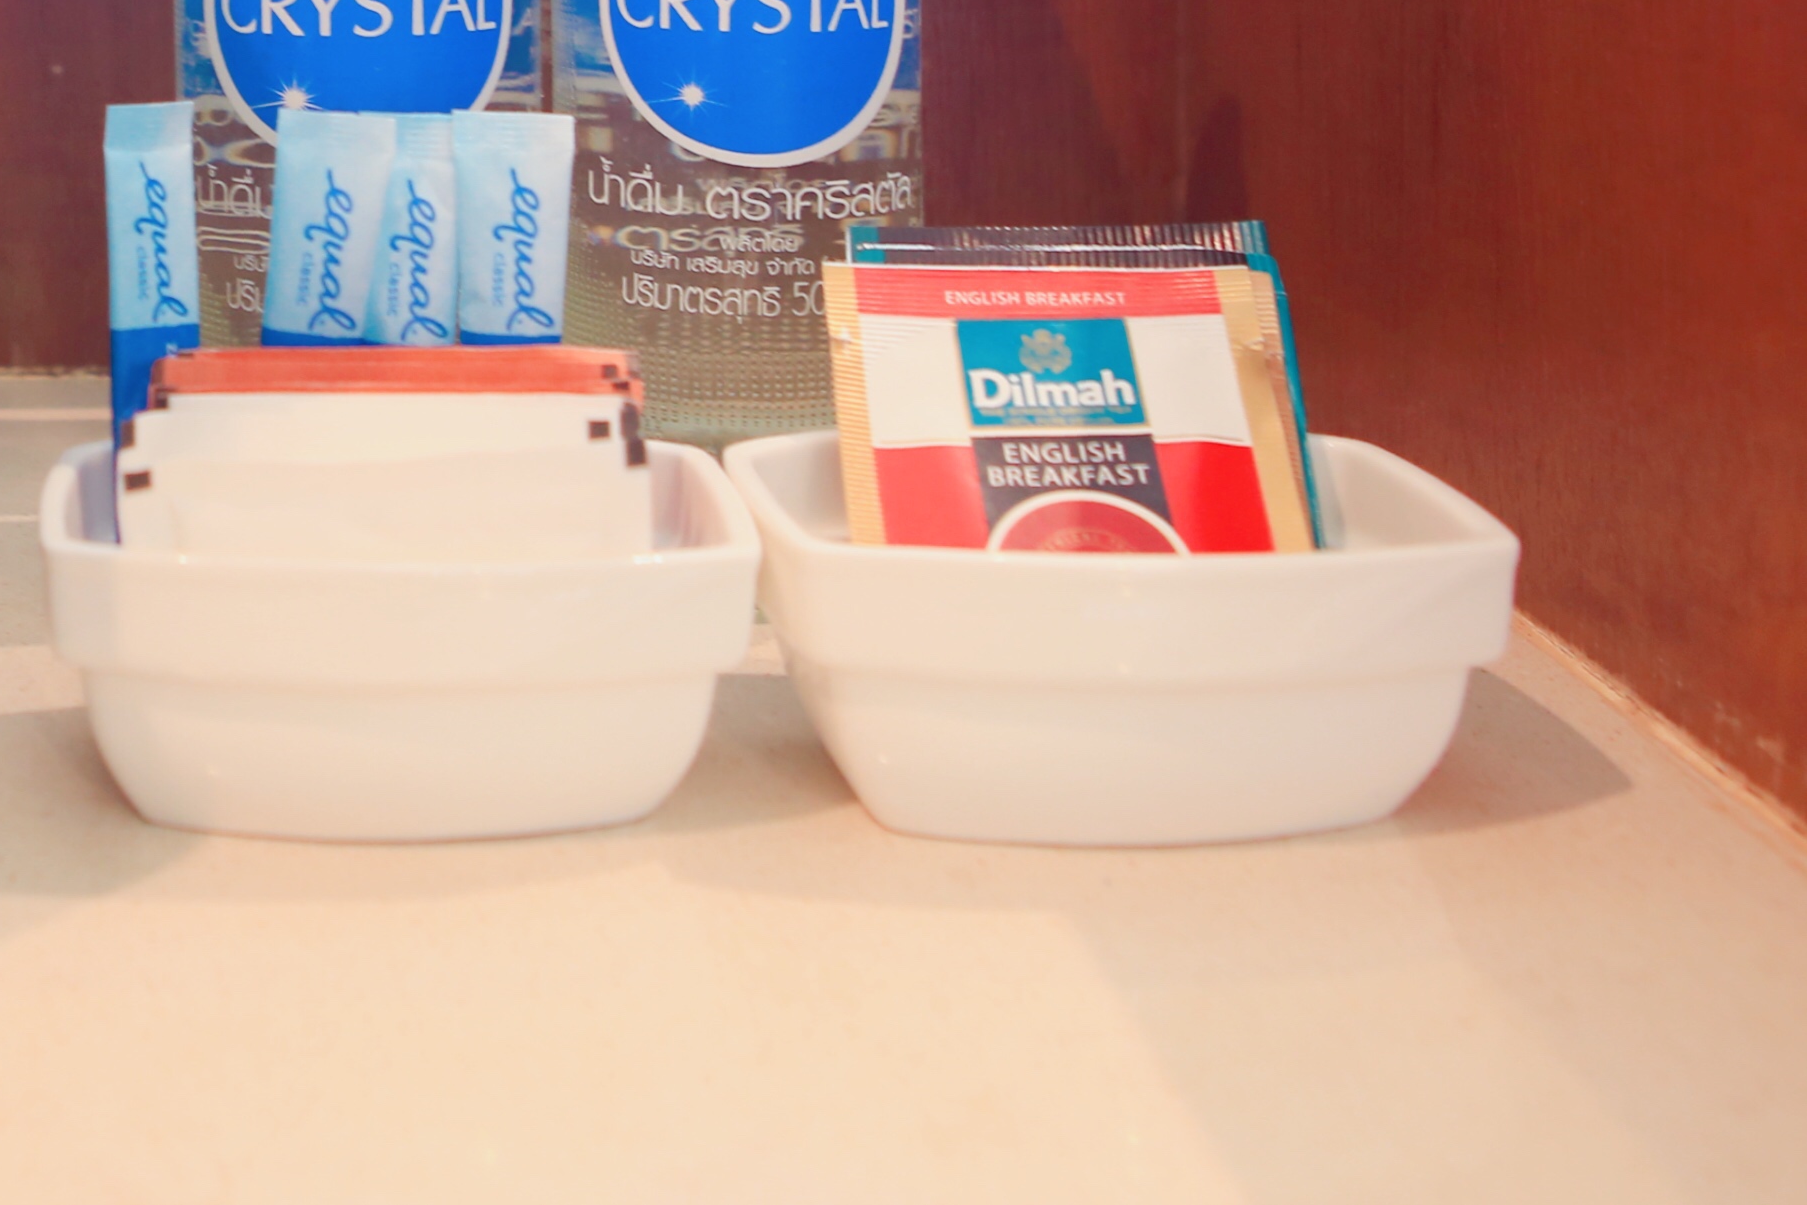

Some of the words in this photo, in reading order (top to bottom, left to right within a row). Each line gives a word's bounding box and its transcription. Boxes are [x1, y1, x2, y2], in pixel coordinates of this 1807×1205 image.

[133, 160, 189, 324] equal
[303, 168, 357, 332] equal
[389, 178, 448, 342] equal
[491, 167, 555, 333] equal
[945, 290, 1021, 307] ENGLISH
[1025, 291, 1127, 308] BREAKFAST
[968, 367, 1138, 410] Dilmah
[986, 462, 1151, 488] BREAKFAST
[1000, 440, 1127, 465] ENGLISH
